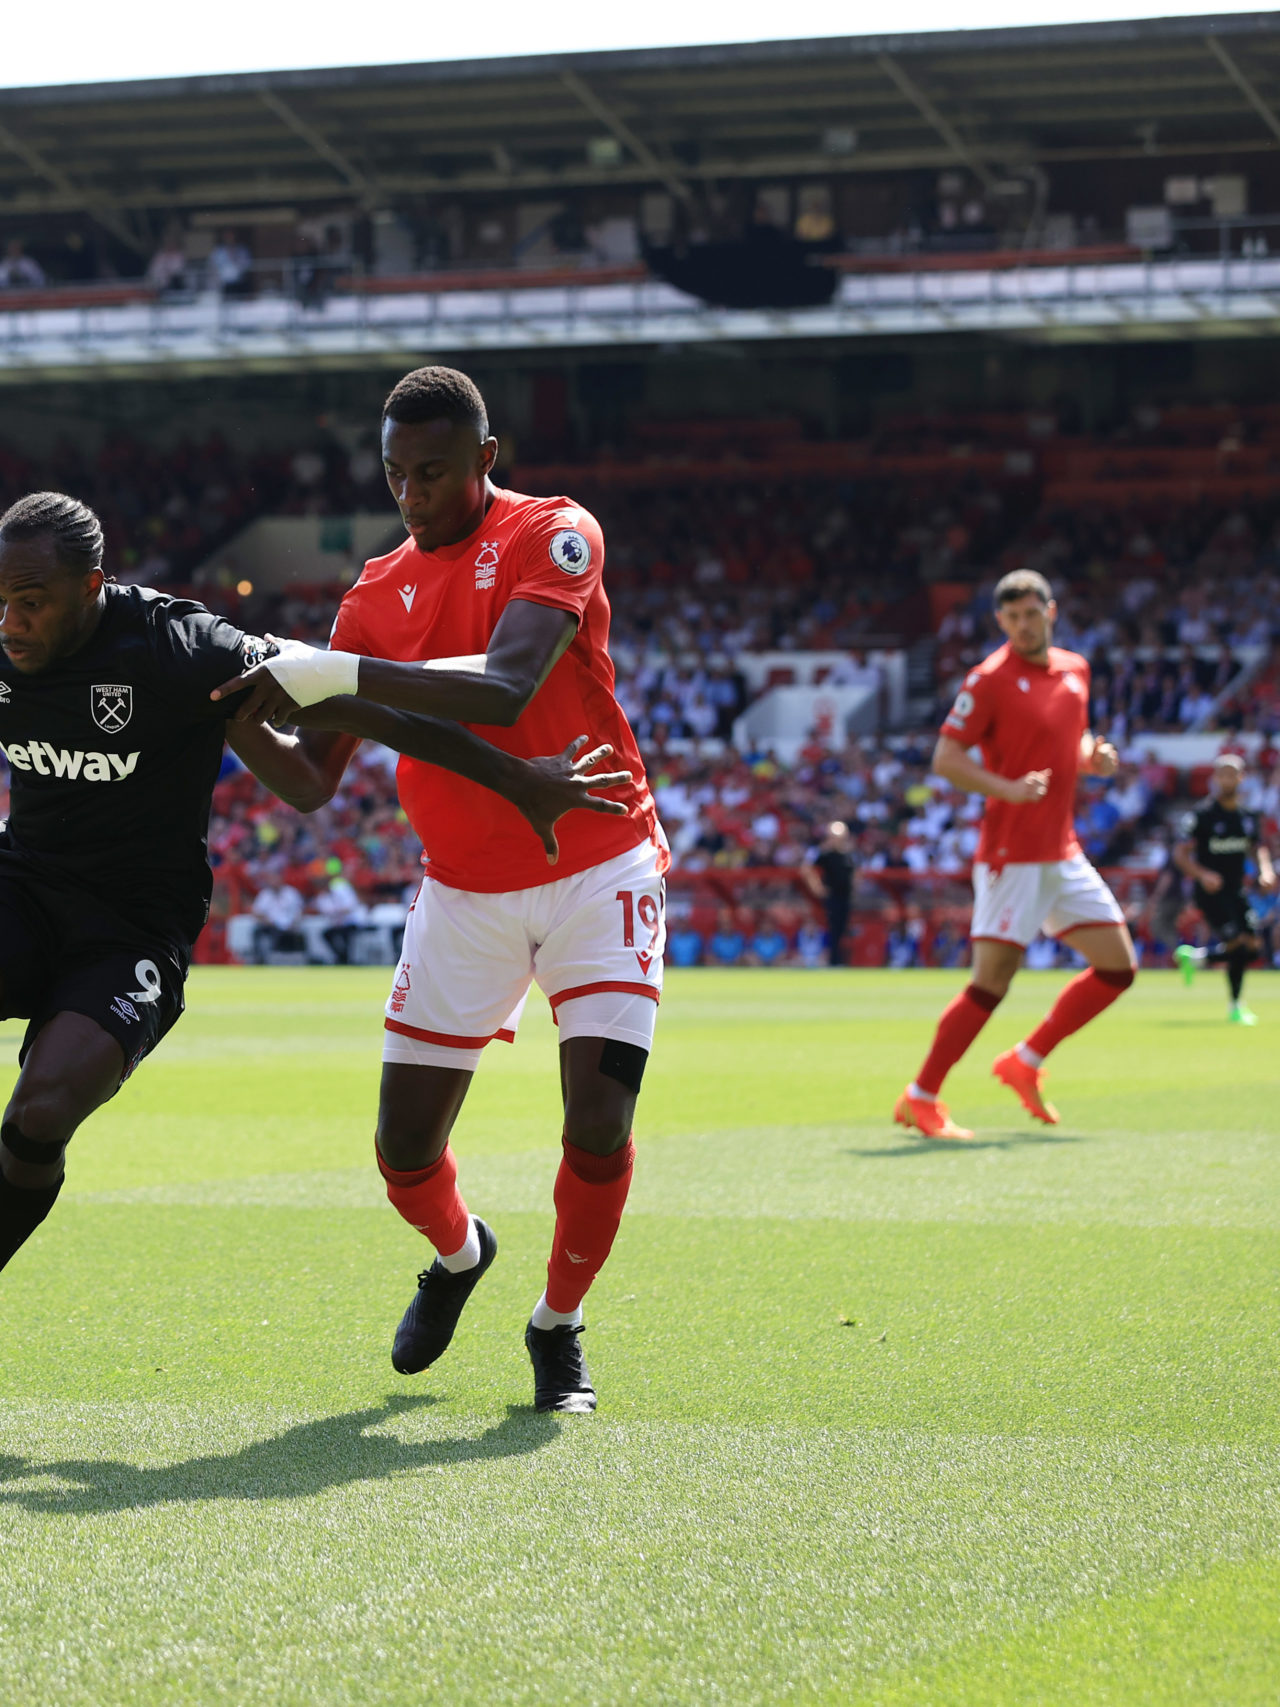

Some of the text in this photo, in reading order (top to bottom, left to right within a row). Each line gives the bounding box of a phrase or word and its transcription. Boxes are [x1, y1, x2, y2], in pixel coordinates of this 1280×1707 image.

[475, 577, 496, 590] FOREST
[616, 891, 659, 950] 19
[125, 959, 162, 1002] 9
[110, 1004, 131, 1025] umbro
